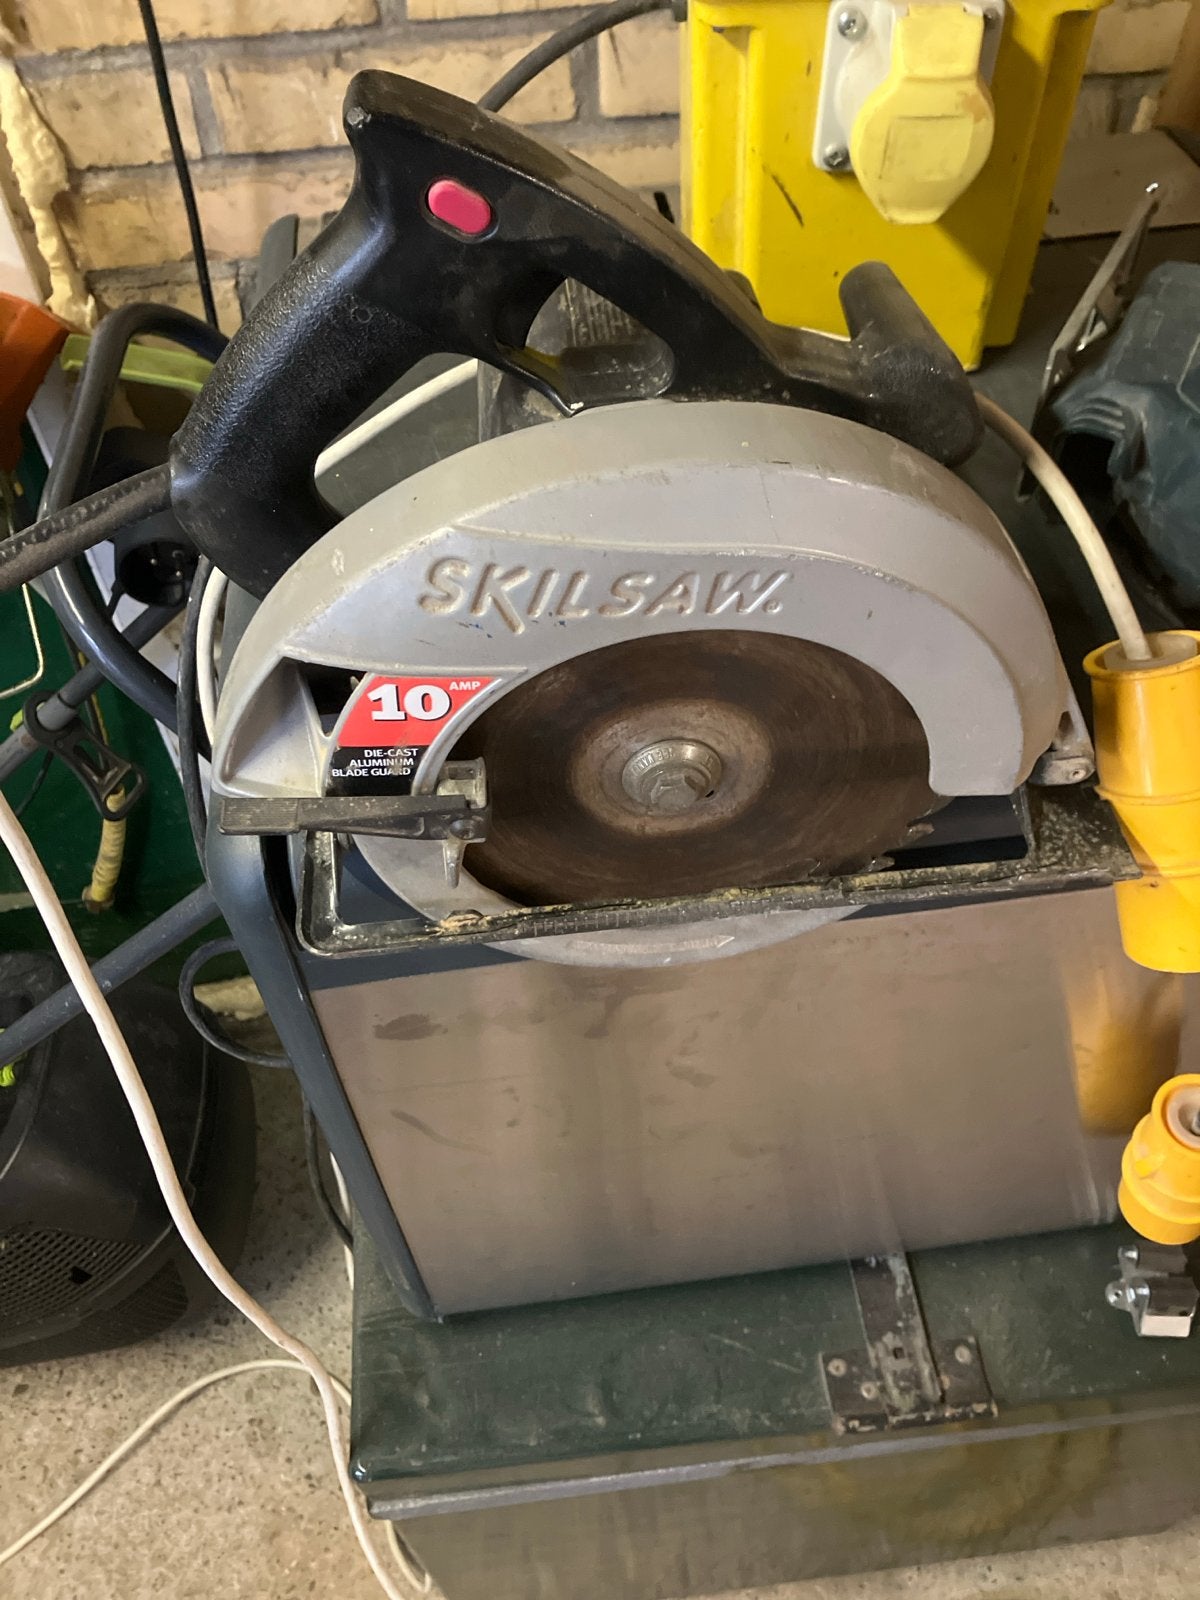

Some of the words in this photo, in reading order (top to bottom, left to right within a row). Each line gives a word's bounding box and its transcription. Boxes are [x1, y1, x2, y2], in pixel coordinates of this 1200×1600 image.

[418, 556, 791, 635] SKILSAW
[367, 683, 452, 721] 10
[449, 681, 481, 691] AMP
[364, 748, 418, 758] DIE-CAST
[349, 757, 414, 768] ALUMINUM
[331, 768, 369, 777] BLADE
